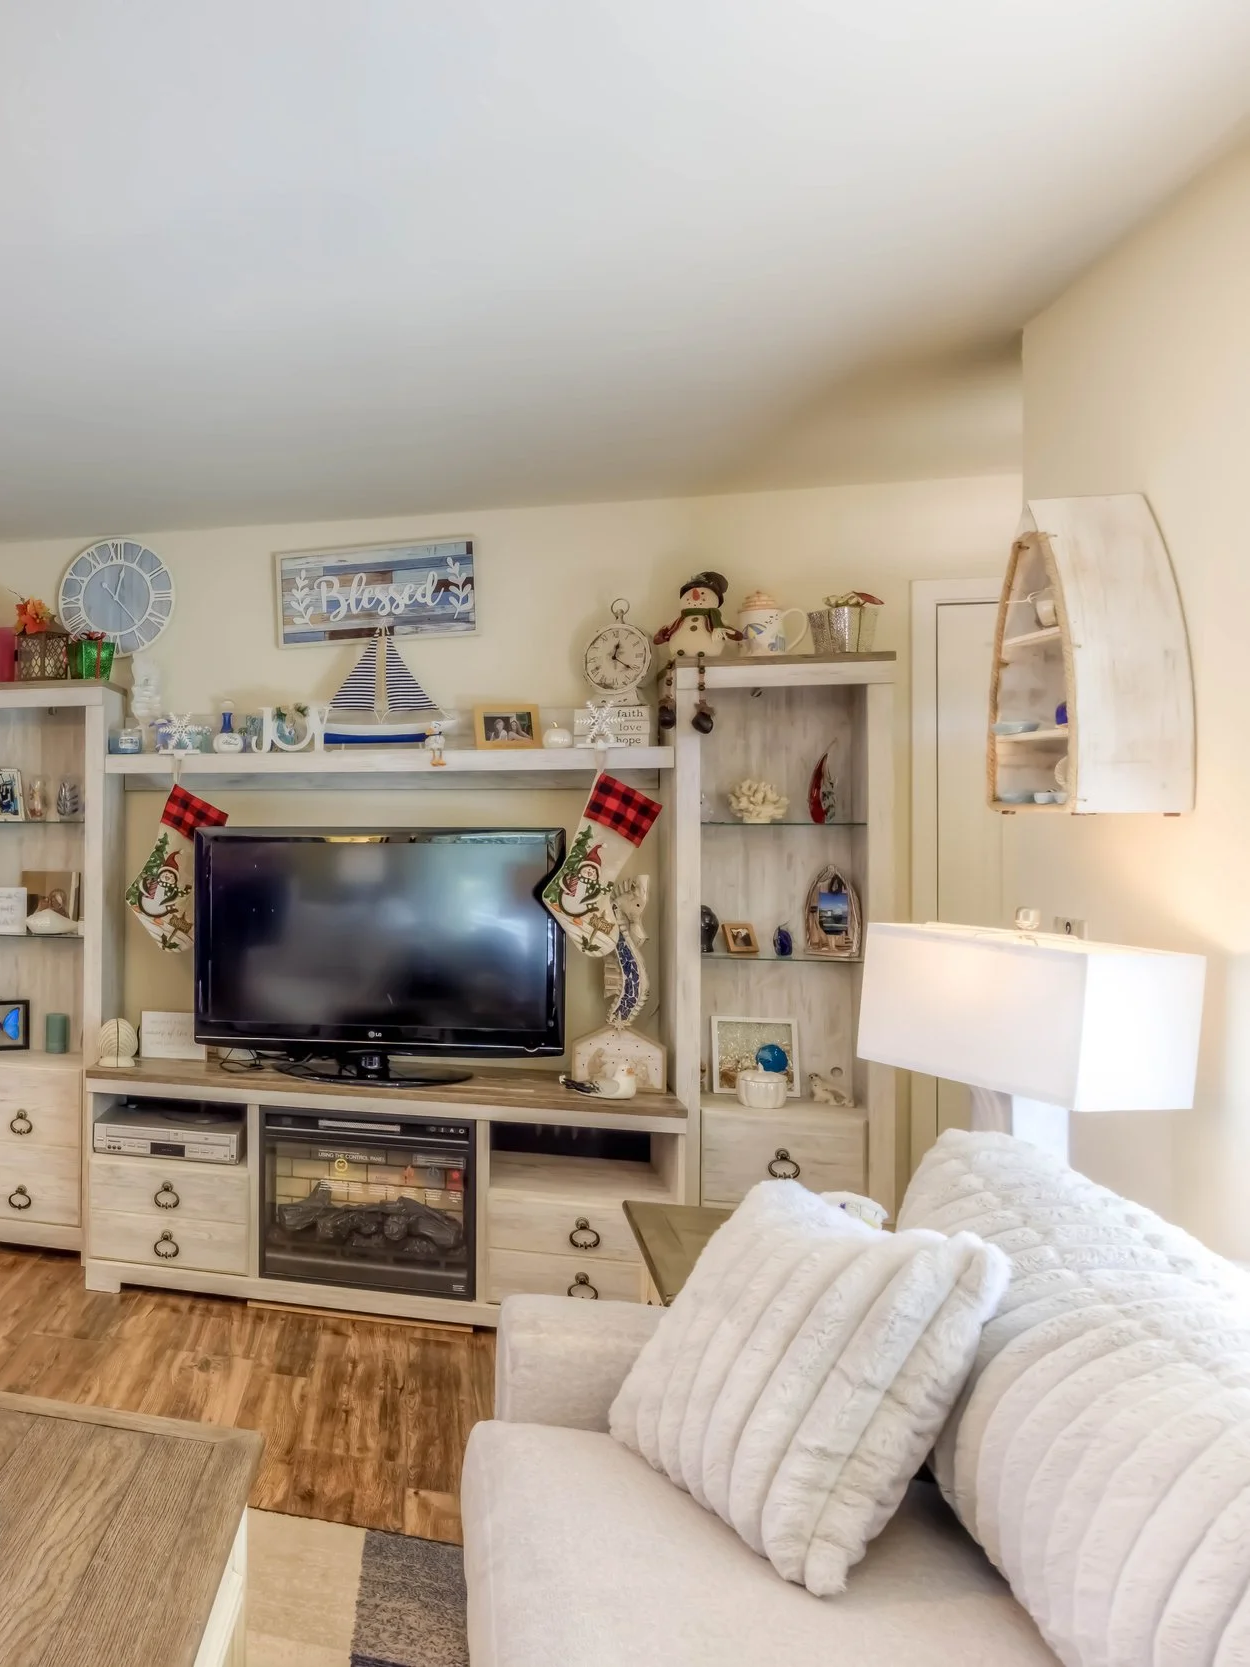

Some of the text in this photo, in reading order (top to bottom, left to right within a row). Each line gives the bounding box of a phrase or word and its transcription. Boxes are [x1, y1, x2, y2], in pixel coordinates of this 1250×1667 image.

[314, 571, 444, 622] Blessed
[617, 709, 643, 718] faith
[619, 723, 642, 731] love
[616, 736, 641, 747] hope
[345, 1153, 368, 1161] CONTROL
